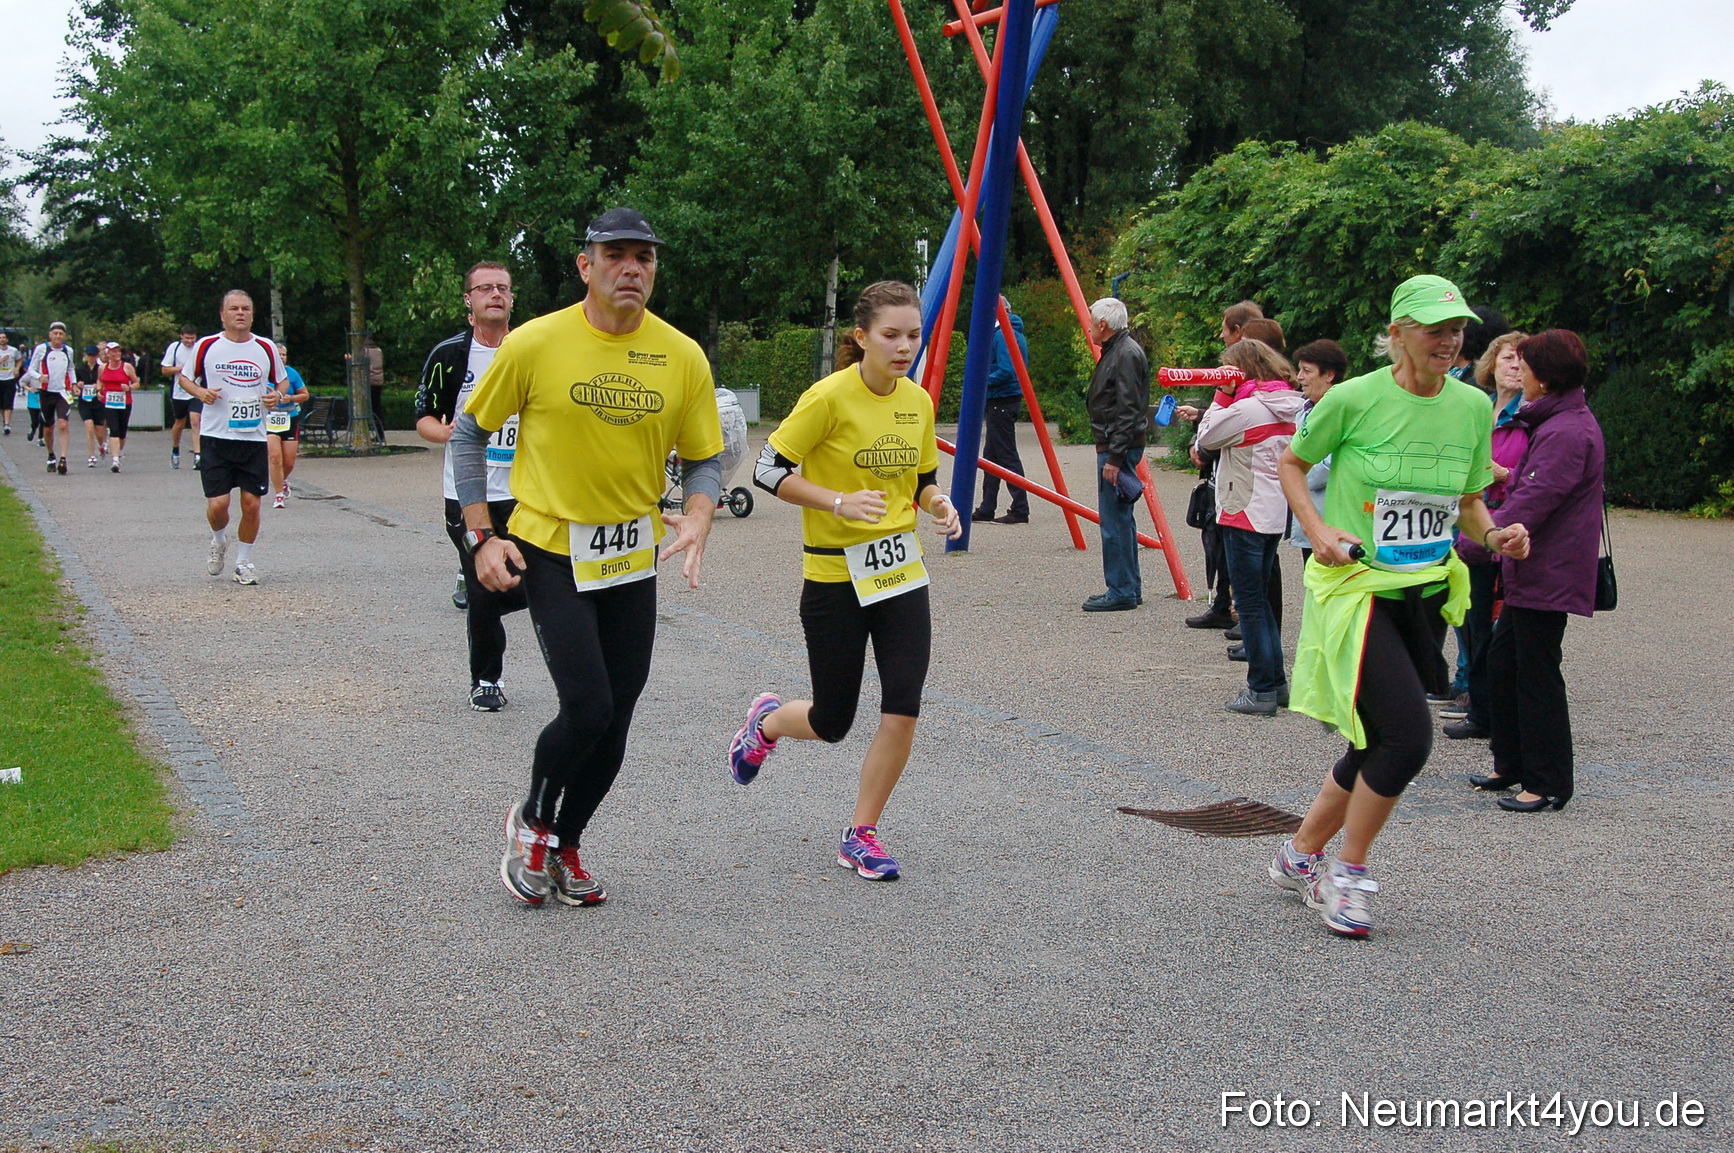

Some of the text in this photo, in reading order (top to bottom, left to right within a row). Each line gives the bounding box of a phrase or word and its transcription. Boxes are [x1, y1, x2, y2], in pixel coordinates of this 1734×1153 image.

[215, 364, 253, 372] GERHART
[1200, 369, 1245, 380] Audi BKK
[592, 375, 642, 391] PIZZERIA
[583, 386, 654, 408] FRANCESCO
[232, 404, 260, 419] 2975
[270, 416, 286, 425] 580
[874, 436, 907, 450] PIZZERIA
[866, 450, 914, 466] FRANCESCO
[1377, 498, 1449, 510] PARTL Neumarkt
[1382, 508, 1450, 541] 2108
[590, 518, 638, 554] 446
[864, 534, 906, 570] 435
[1393, 547, 1436, 562] Christine
[602, 560, 630, 576] Bruno
[874, 572, 906, 590] Denise
